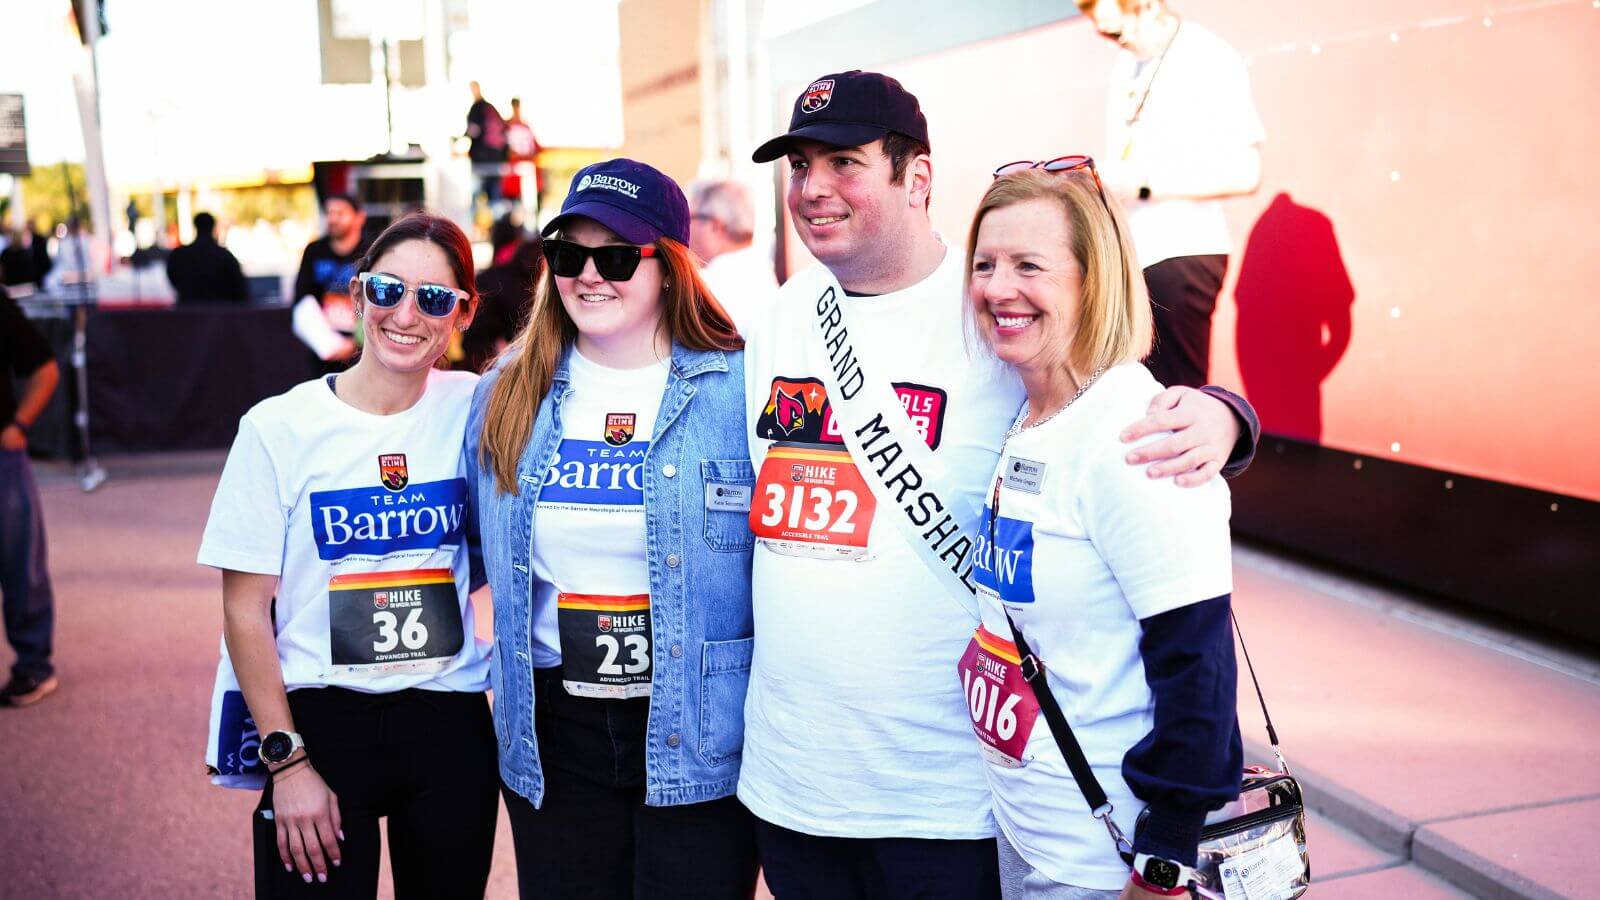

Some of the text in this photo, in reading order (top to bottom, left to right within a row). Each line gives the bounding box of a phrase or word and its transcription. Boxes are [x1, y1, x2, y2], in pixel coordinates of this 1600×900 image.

[592, 174, 641, 194] Barrow
[817, 285, 865, 401] GRAND
[587, 448, 645, 458] TEAM
[805, 465, 837, 480] HIKE
[371, 493, 425, 506] TEAM
[761, 483, 858, 534] 3132
[319, 504, 463, 545] Barrow
[389, 590, 422, 603] HIKE
[373, 607, 428, 653] 36
[612, 615, 646, 628] HIKE
[375, 653, 410, 661] ADVANCED
[595, 634, 650, 675] 23
[985, 658, 1008, 679] HIKE
[963, 668, 1023, 741] 1016
